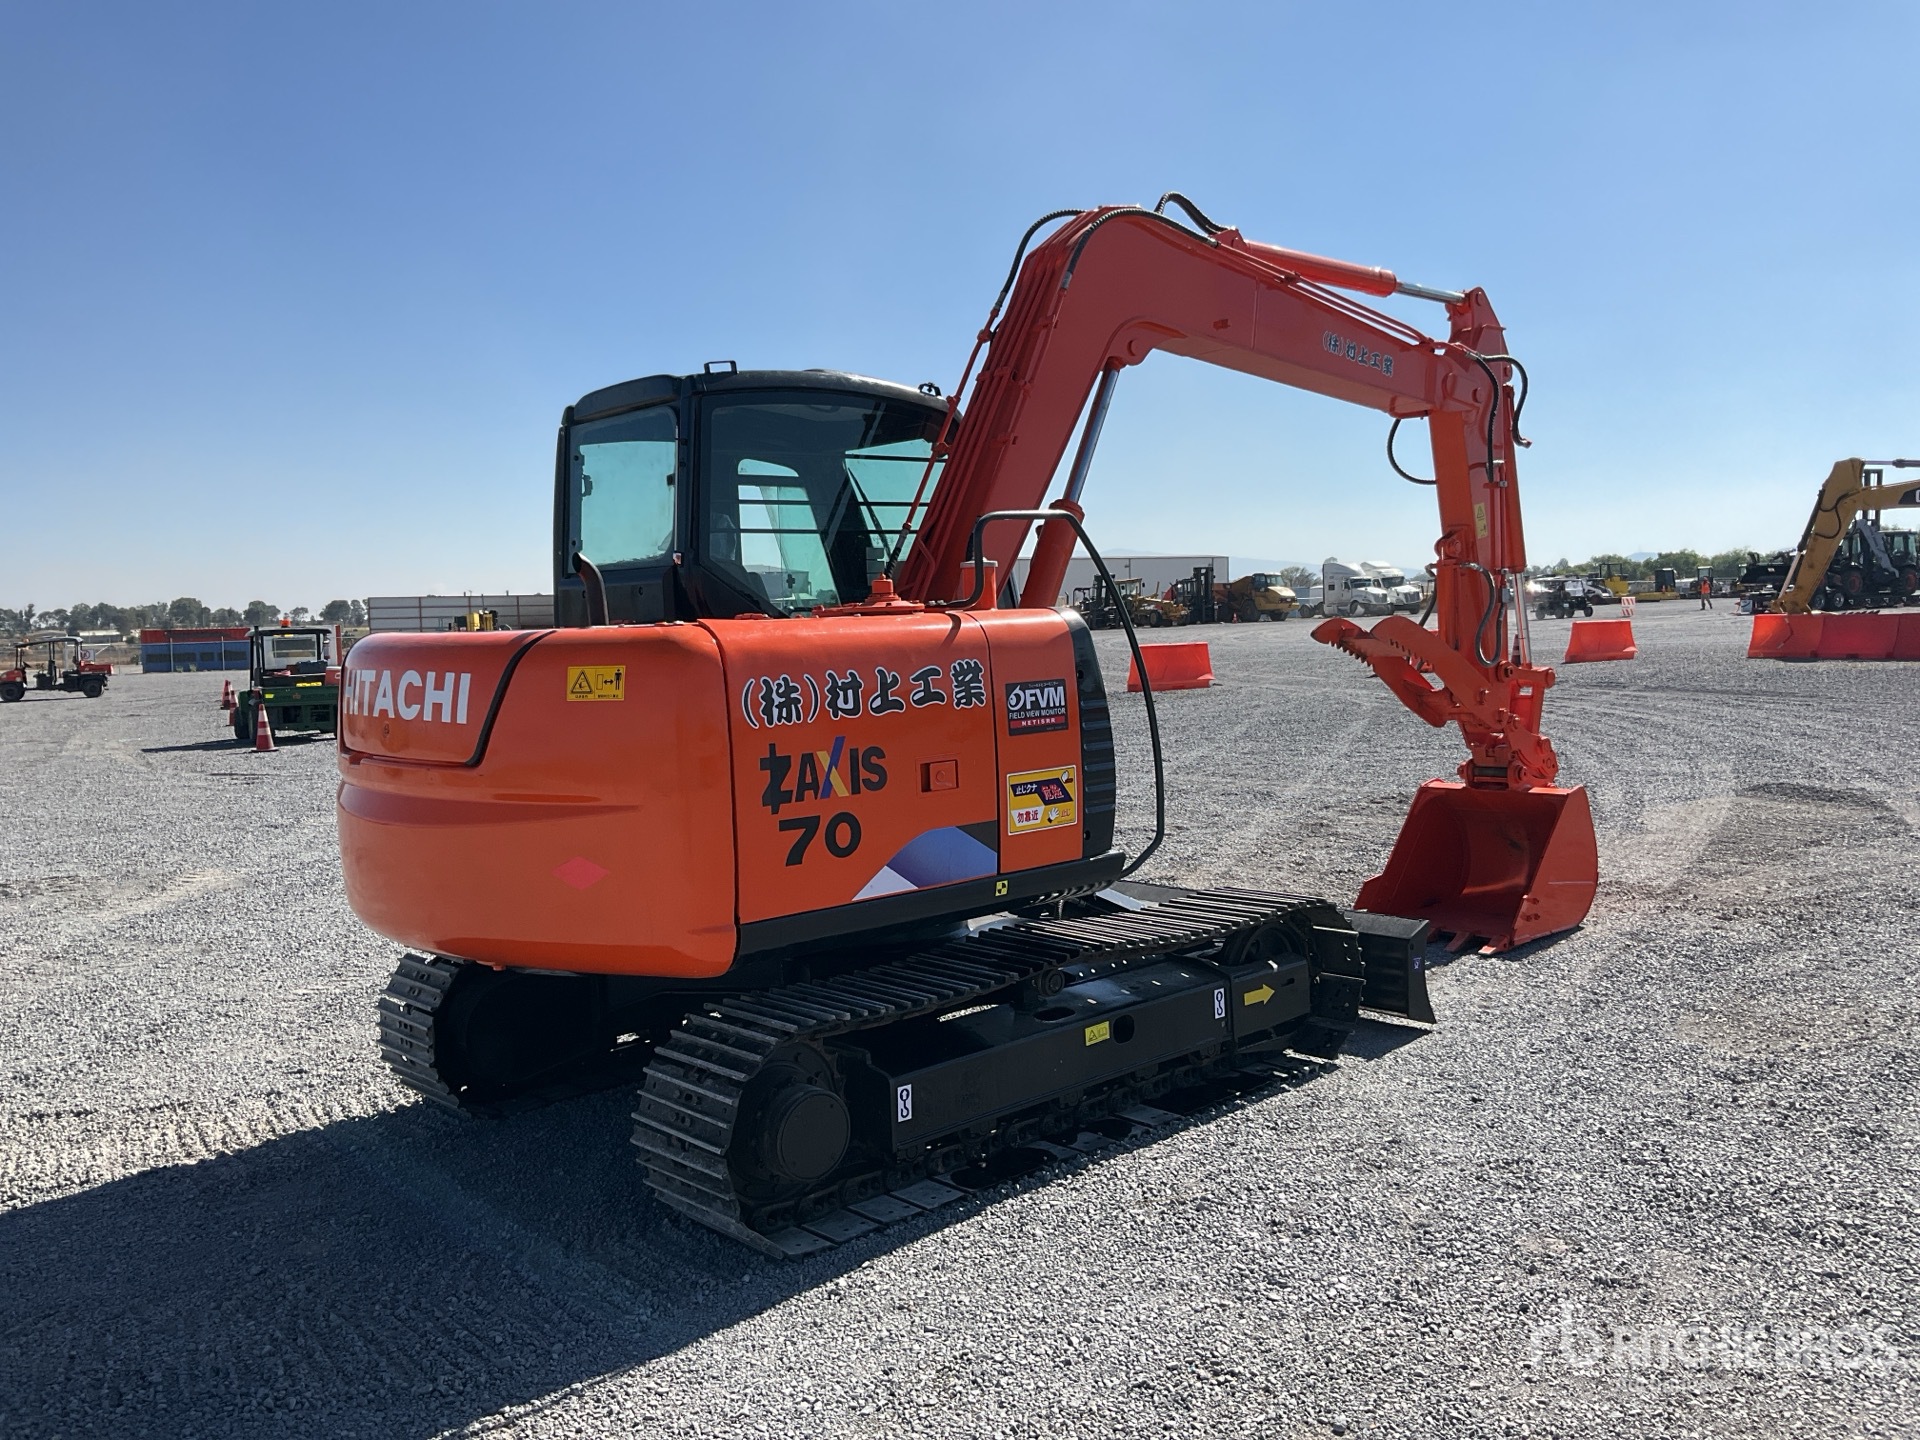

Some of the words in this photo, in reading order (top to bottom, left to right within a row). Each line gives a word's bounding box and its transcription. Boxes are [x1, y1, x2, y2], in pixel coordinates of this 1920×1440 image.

[343, 669, 472, 724] HITACHI
[742, 659, 986, 729] (株)村上工業
[1009, 711, 1026, 720] FIELD
[1026, 709, 1041, 718] VIEW
[1041, 707, 1066, 716] MONITOR
[1025, 686, 1066, 710] FVM
[758, 735, 888, 815] ZAXIS
[778, 811, 862, 867] 70
